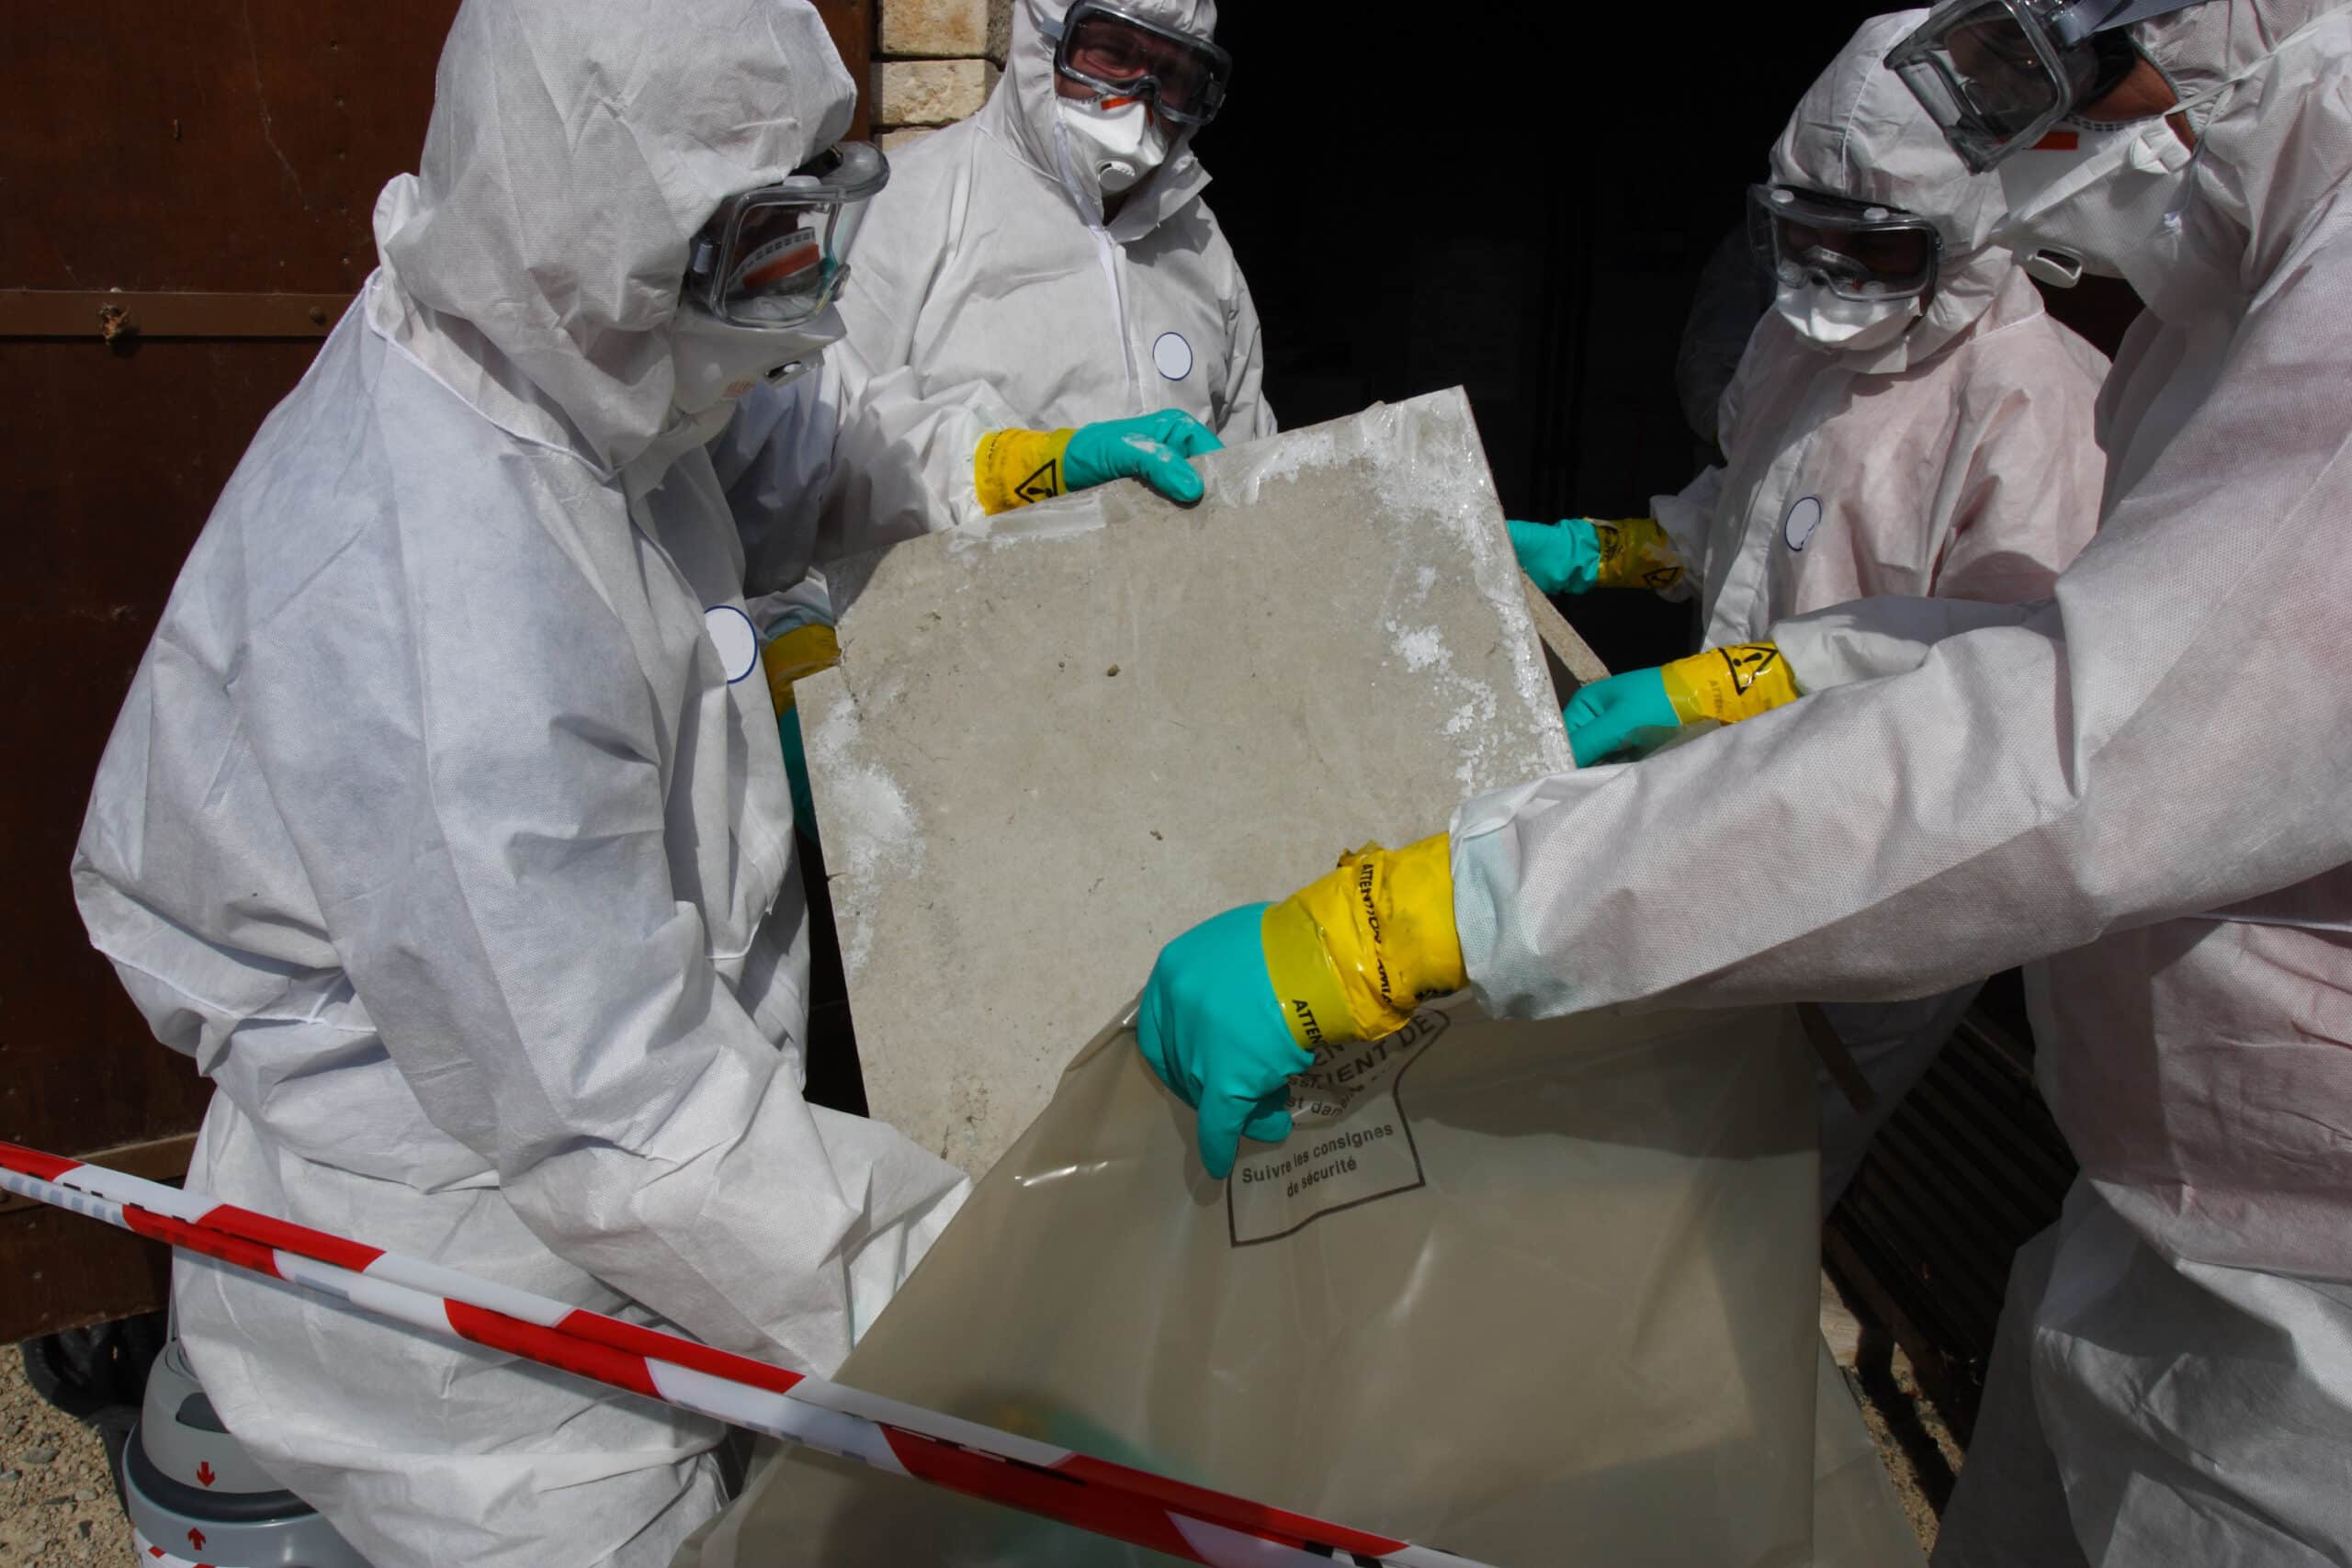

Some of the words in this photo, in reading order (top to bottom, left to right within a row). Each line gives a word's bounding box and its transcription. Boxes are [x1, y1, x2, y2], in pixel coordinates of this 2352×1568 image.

[1397, 1014, 1436, 1048] DE
[1241, 1160, 1292, 1184] Suivre
[1293, 1152, 1309, 1168] les
[1313, 1123, 1394, 1158] consignes
[1287, 1182, 1299, 1198] de
[1301, 1155, 1357, 1190] sécurité
